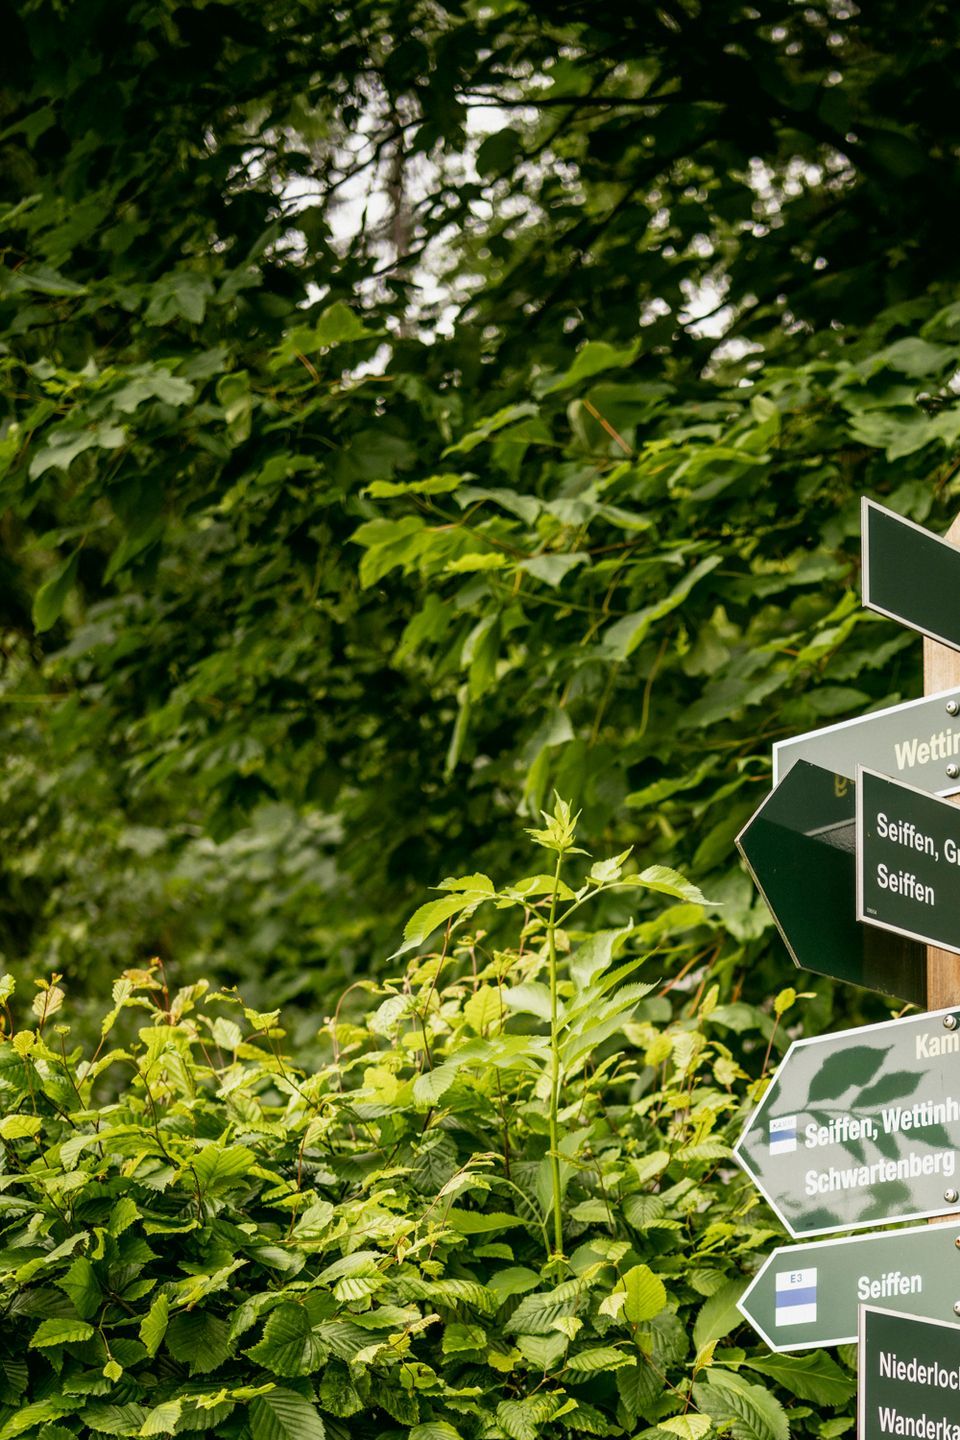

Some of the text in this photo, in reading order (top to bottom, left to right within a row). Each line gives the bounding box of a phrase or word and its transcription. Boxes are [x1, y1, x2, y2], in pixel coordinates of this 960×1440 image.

[876, 812, 939, 861] Seiffen,
[876, 863, 935, 906] Seiffen
[804, 1116, 878, 1149] Seiffen,
[805, 1150, 955, 1196] Schwartenberg
[790, 1273, 803, 1284] E3
[857, 1271, 922, 1301] Seiffen
